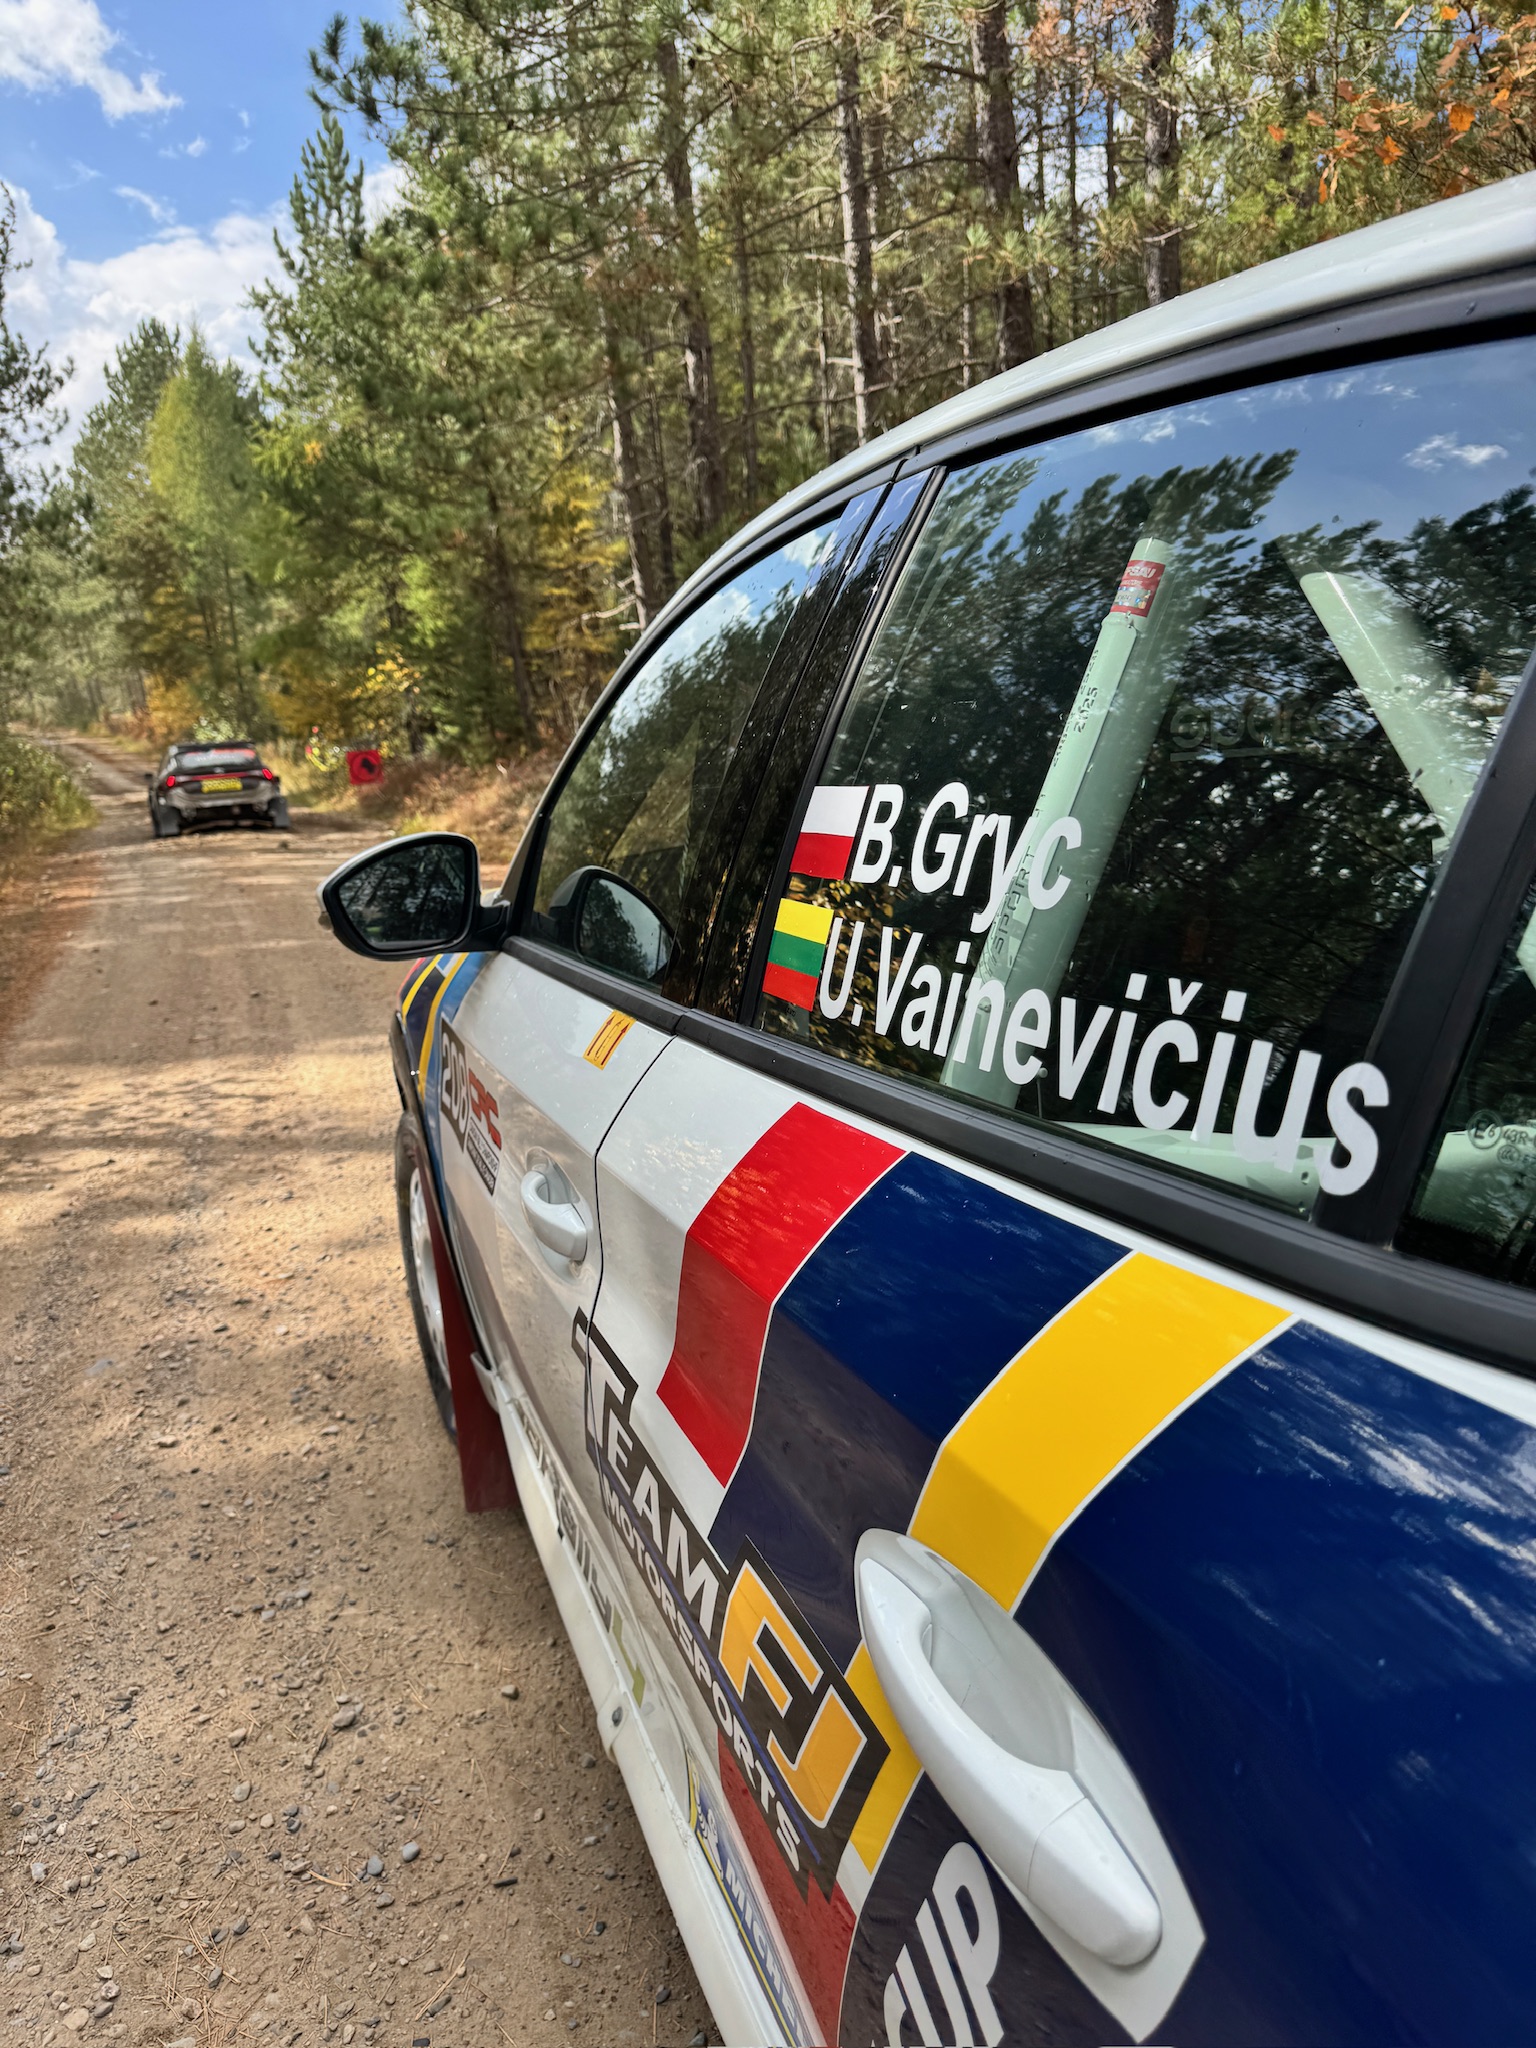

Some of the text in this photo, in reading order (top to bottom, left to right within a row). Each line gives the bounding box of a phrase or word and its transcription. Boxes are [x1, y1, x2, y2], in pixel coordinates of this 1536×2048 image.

[851, 782, 1082, 933] B.Gryc
[992, 845, 1035, 954] SPORT
[441, 1031, 469, 1134] 208
[819, 916, 1389, 1196] U.Vainevičius
[575, 1325, 868, 1829] TEAM FJ
[602, 1473, 801, 1872] MOTORSPORTS
